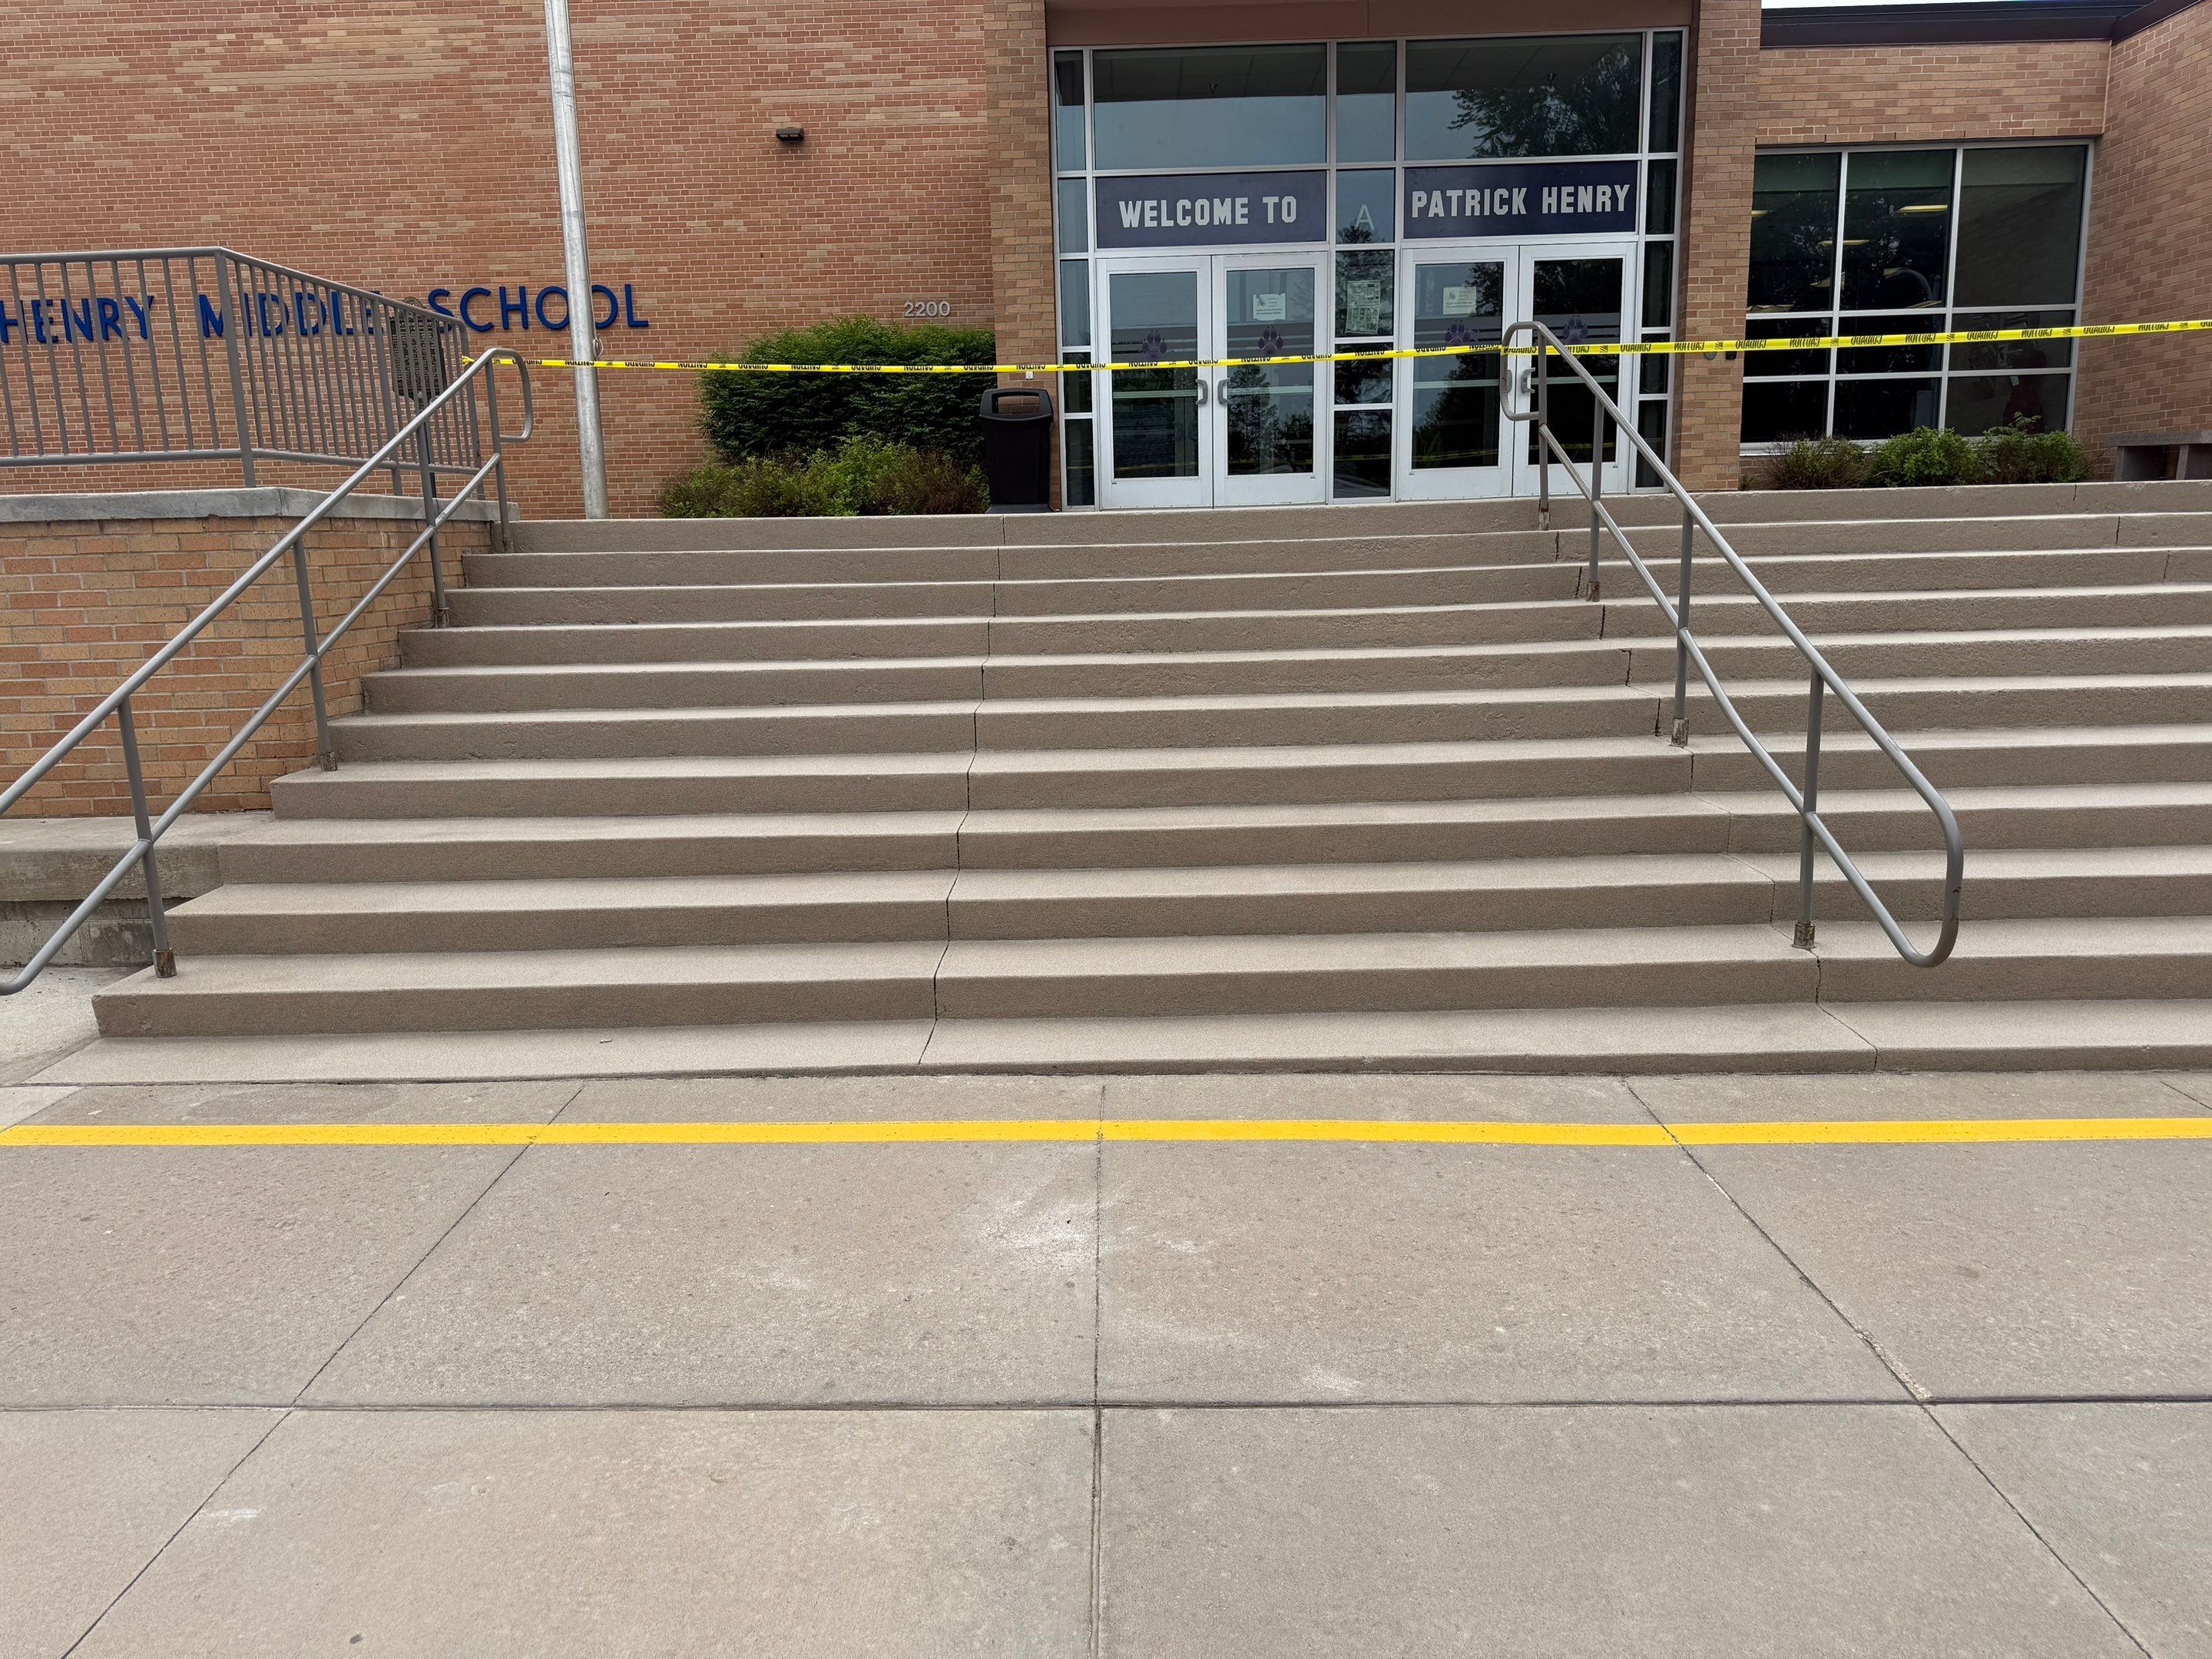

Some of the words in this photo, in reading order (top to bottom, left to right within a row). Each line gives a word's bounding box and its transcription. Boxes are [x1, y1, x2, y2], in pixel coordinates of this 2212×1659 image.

[1118, 196, 1249, 229] WELCOME
[1263, 195, 1298, 224] TO
[1354, 204, 1375, 230] A
[1412, 187, 1527, 219] PATRICK
[1541, 184, 1631, 215] HENRY
[0, 296, 154, 343] HENRY
[428, 283, 649, 333] SCHOOL
[904, 300, 952, 317] 2200
